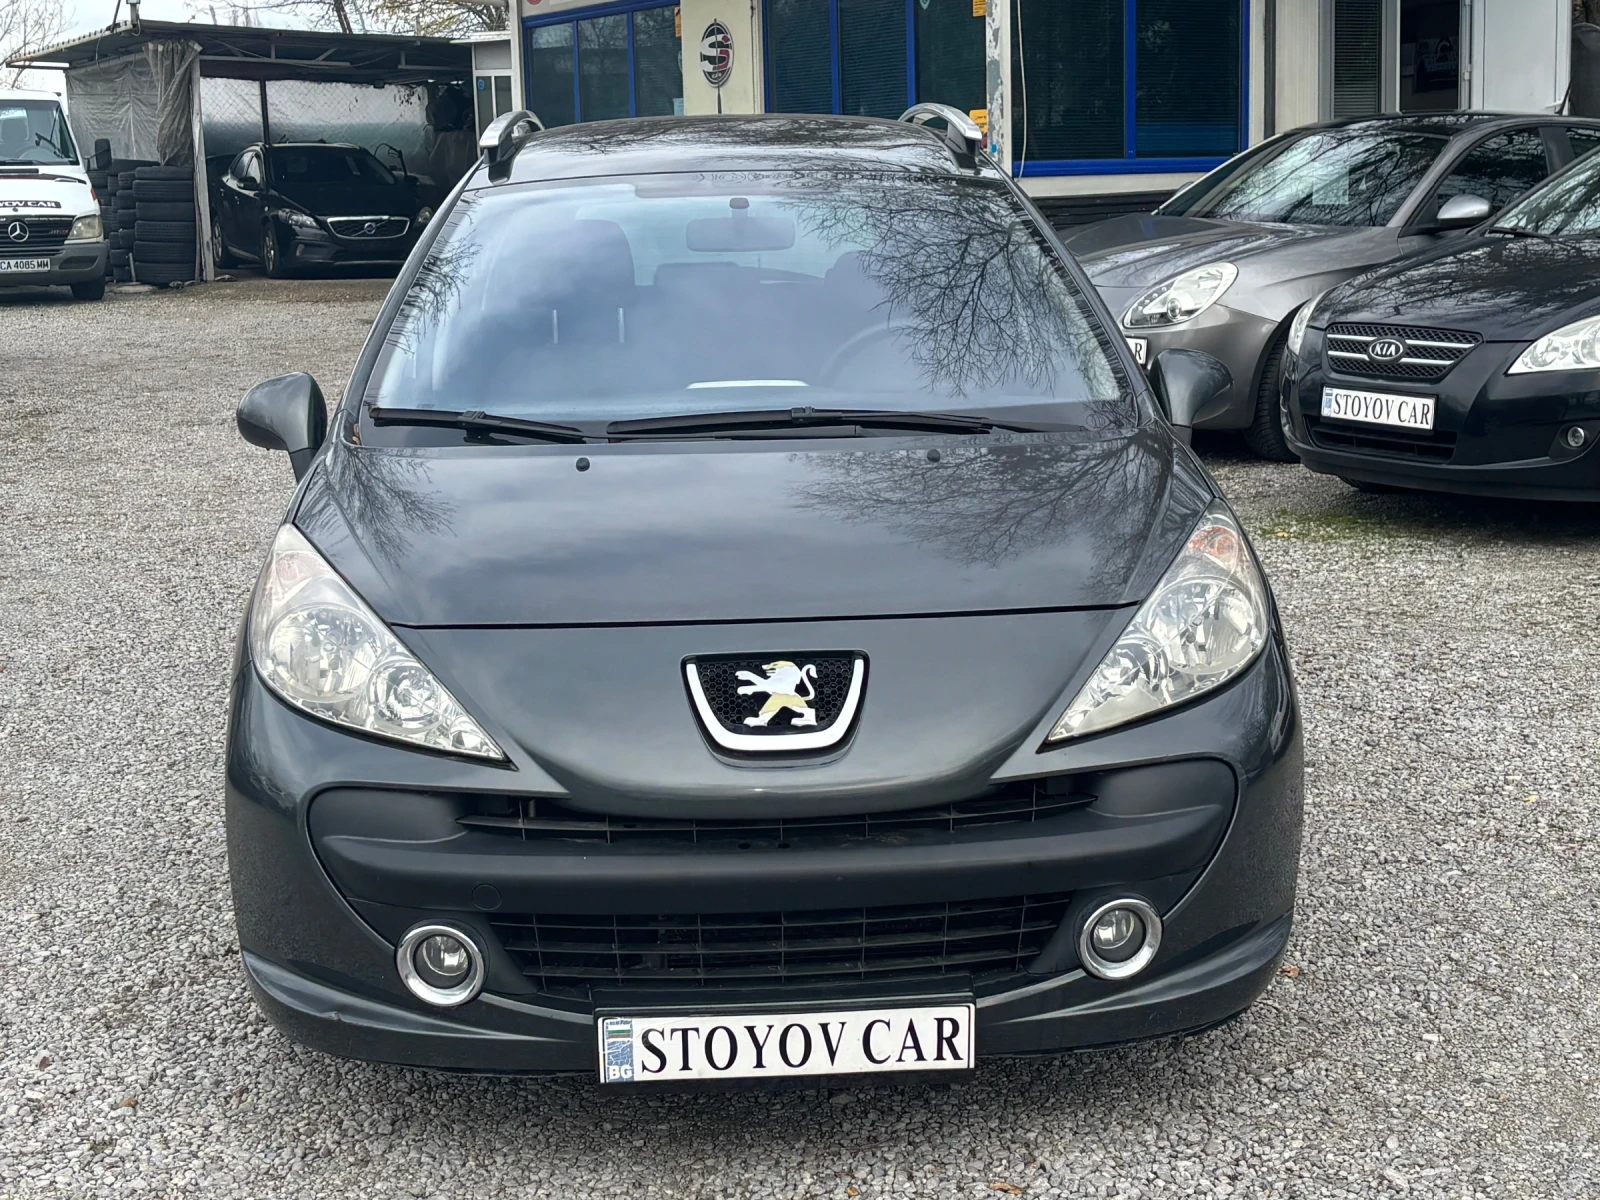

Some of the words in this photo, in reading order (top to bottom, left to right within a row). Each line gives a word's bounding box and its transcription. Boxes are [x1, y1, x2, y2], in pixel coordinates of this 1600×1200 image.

[0, 260, 12, 270] CA
[14, 260, 35, 270] 4085
[37, 259, 49, 269] MM
[1374, 343, 1396, 356] KIA
[1333, 392, 1395, 421] STOYOV
[1397, 400, 1431, 426] CAR
[641, 1022, 848, 1074] STOYOV
[862, 1017, 965, 1065] CAR
[608, 1064, 633, 1080] BG
